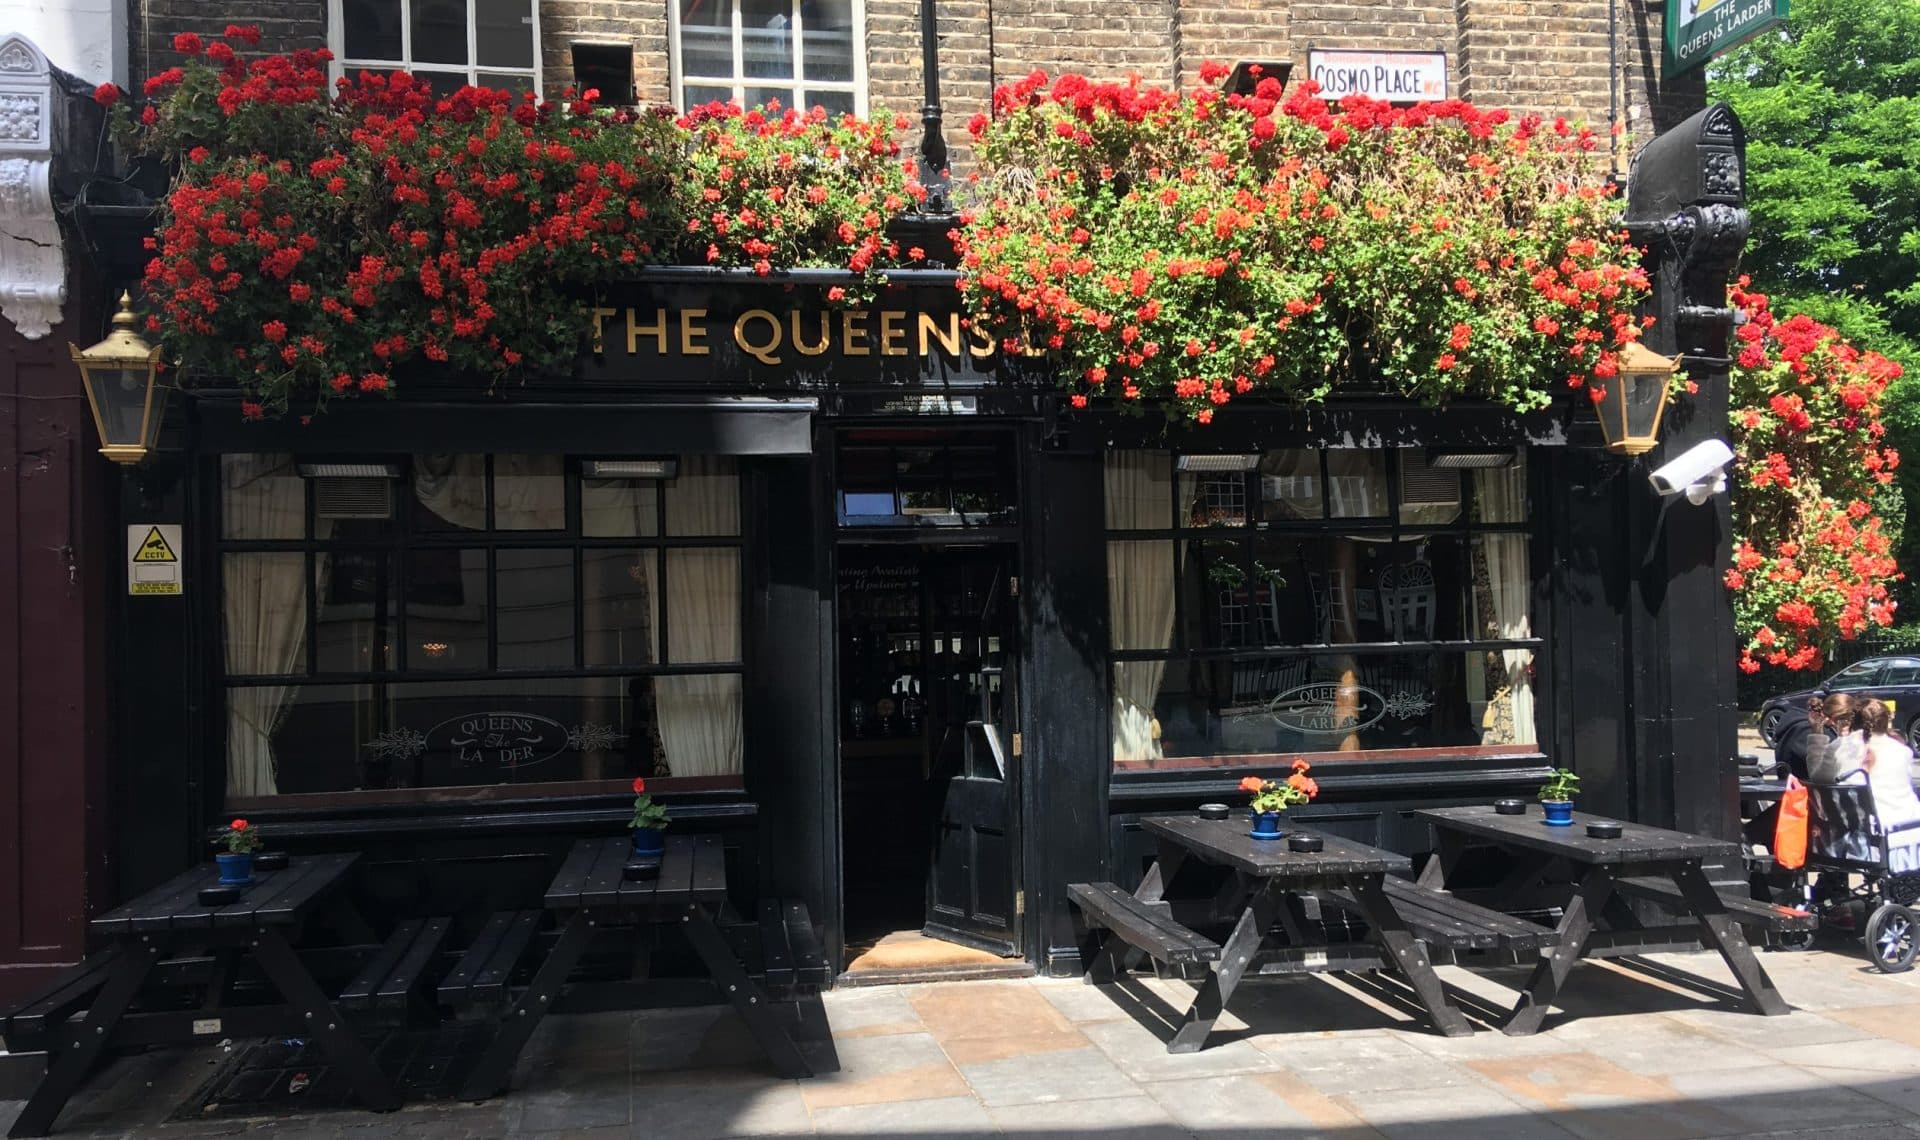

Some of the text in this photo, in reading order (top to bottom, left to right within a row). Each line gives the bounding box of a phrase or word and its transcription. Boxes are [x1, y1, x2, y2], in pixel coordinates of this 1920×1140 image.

[1714, 1, 1736, 22] THE
[1680, 0, 1772, 59] QUEENS LARDER
[1315, 64, 1370, 93] COSMO
[1375, 66, 1422, 94] PLACE
[579, 308, 710, 355] THE
[733, 309, 997, 365] QUEENS
[144, 551, 165, 559] CCTV
[461, 717, 534, 735] QUEENS
